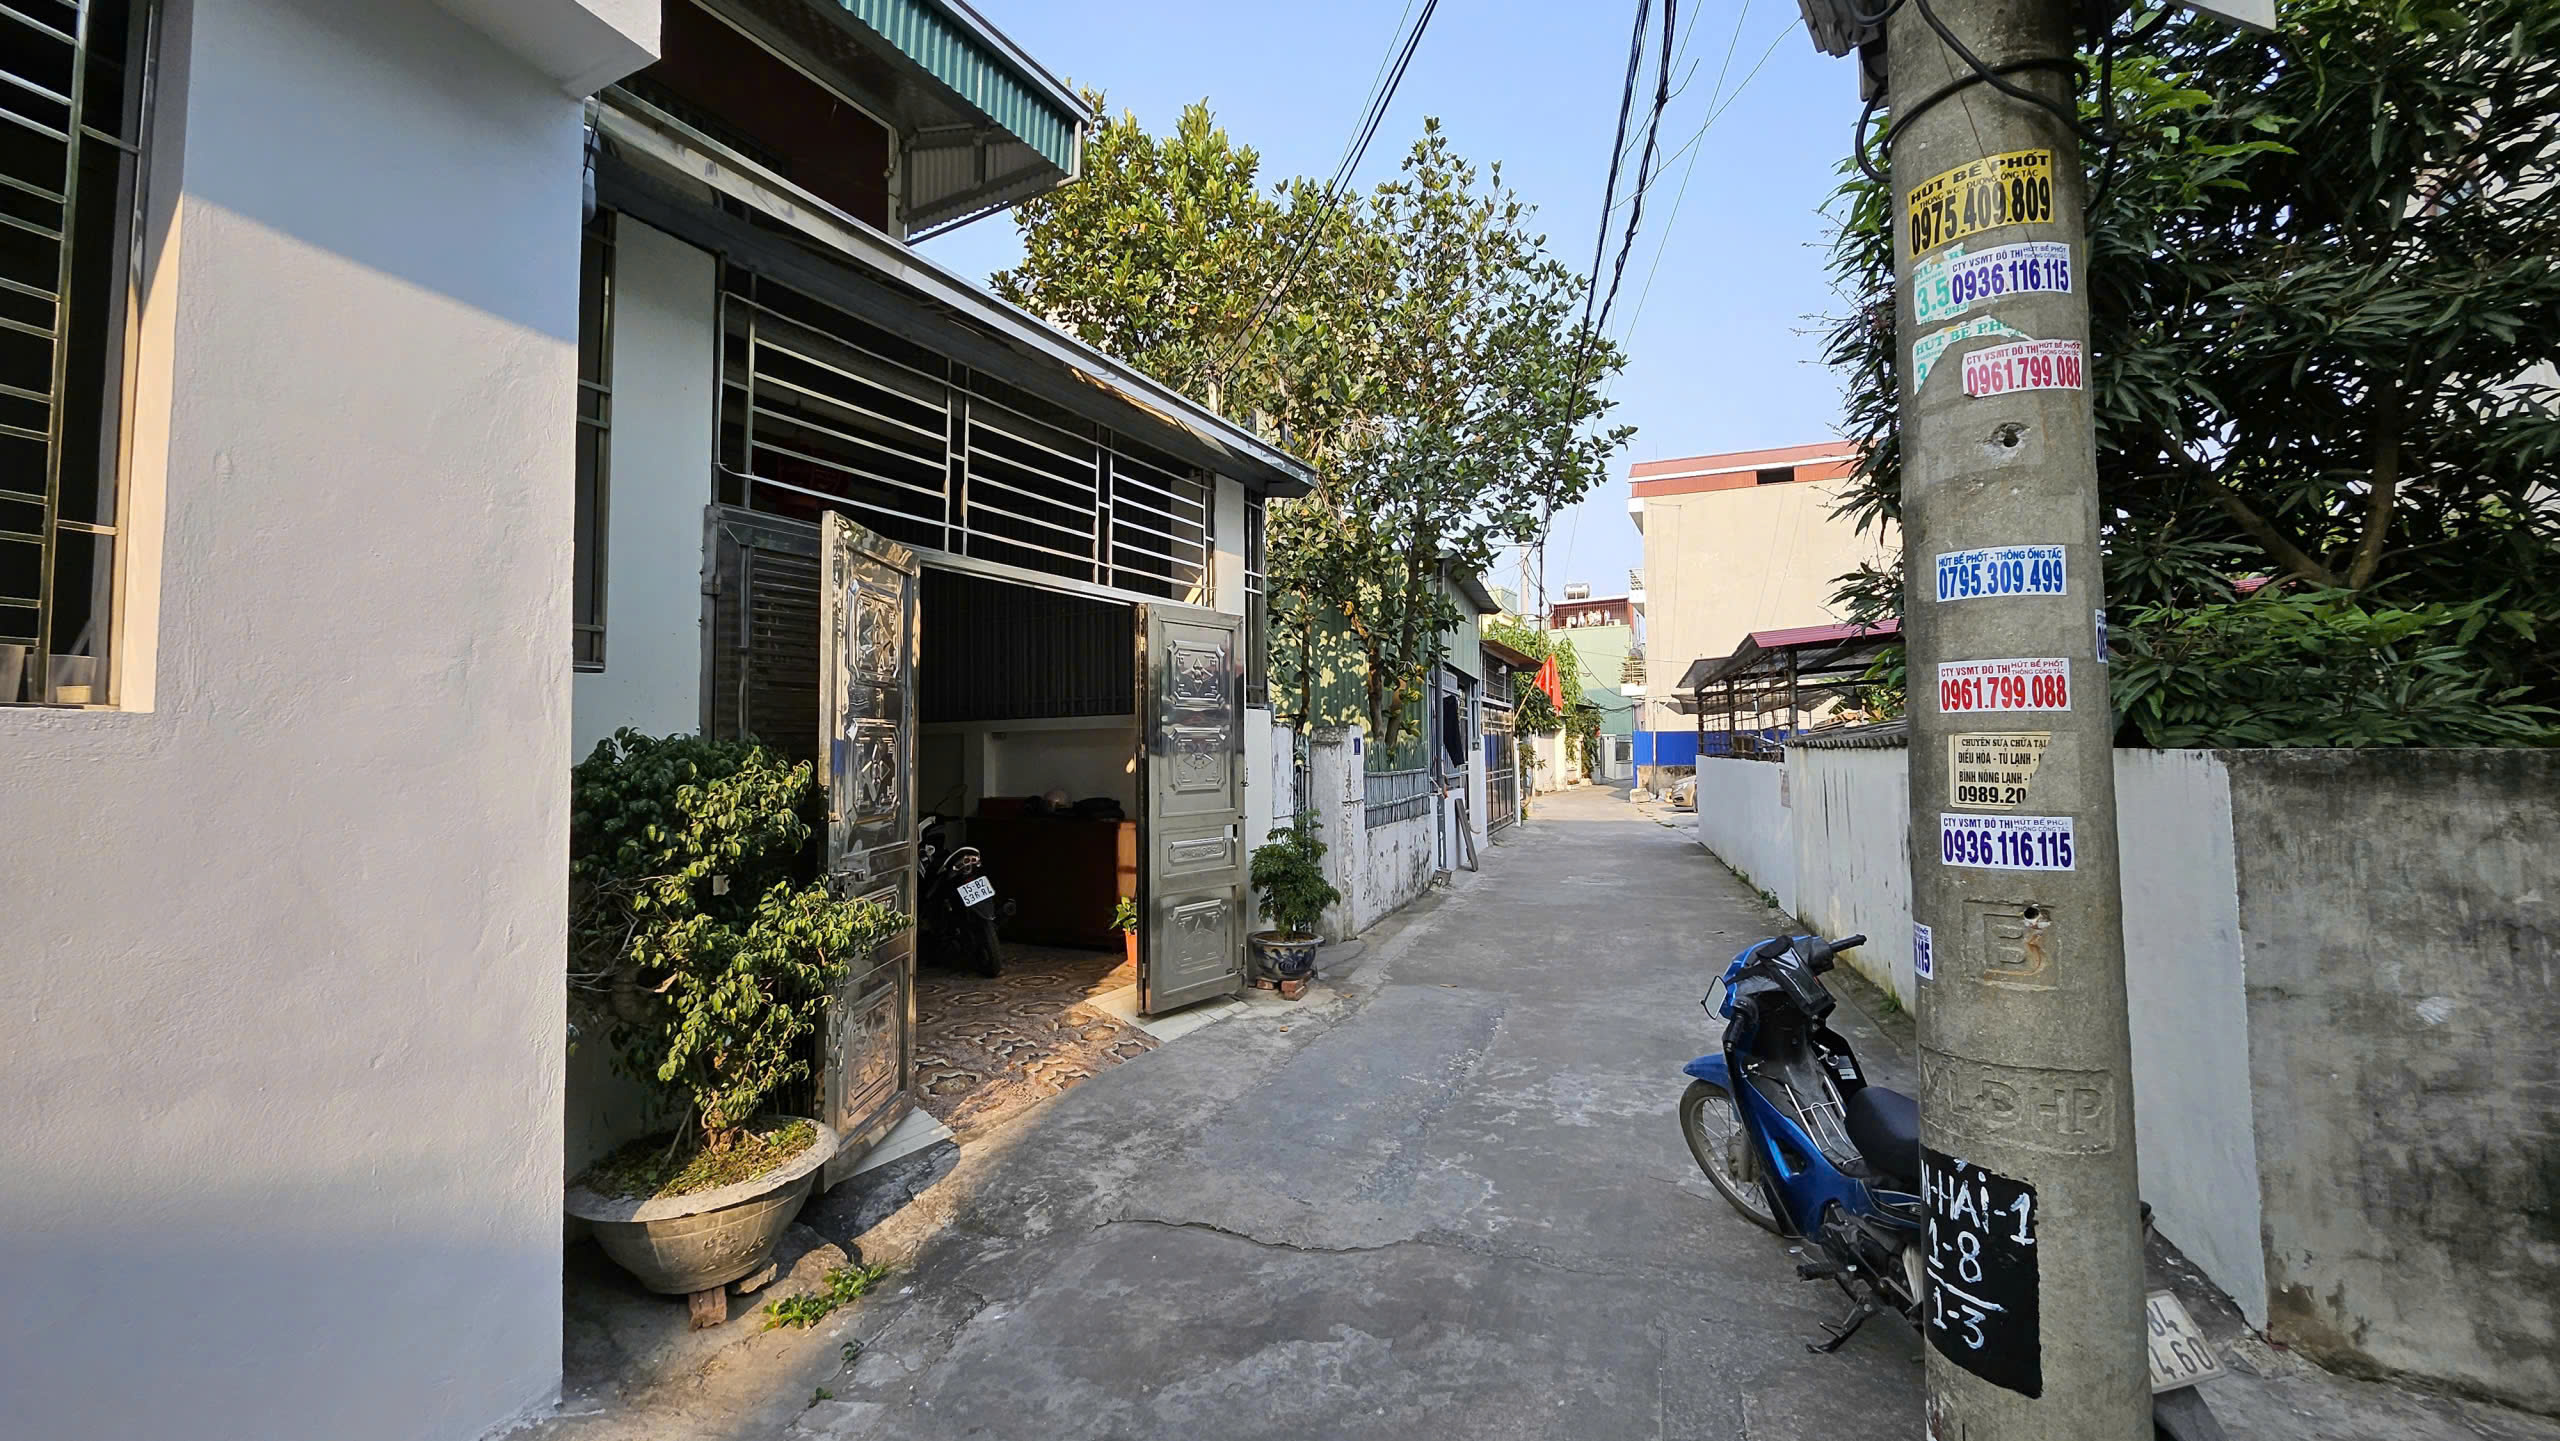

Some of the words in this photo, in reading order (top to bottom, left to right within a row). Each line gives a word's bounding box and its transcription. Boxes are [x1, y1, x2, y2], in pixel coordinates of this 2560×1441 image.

[1991, 151, 2049, 172] PHỐT
[1911, 176, 2050, 256] 0975.409.809
[1952, 260, 1967, 273] CTY
[1969, 254, 1993, 267] VSMT
[1952, 258, 2069, 305] 0936.116.115
[1967, 355, 1981, 366] CTY
[1984, 349, 2009, 361] VSMT
[2012, 344, 2024, 356] ĐÔ
[1967, 355, 2080, 396] 0961.799.088
[1938, 556, 1953, 568] HÚT
[1966, 550, 1988, 563] PHỐT
[1995, 549, 2025, 561] THÔNG
[2027, 547, 2045, 559] ỐNG
[2047, 547, 2062, 559] TẮC
[1939, 560, 2063, 599] 0795.309.499
[1941, 668, 1954, 678] CTY
[1956, 666, 1979, 676] VSMT
[1982, 664, 1994, 675] ĐÔ
[1996, 664, 2011, 676] THỊ
[2011, 660, 2028, 668] HÚT
[1941, 675, 2067, 711] 0961.799.088
[1961, 737, 1990, 747] CHUYÊN
[2010, 753, 2031, 767] LẠNH
[1943, 818, 1956, 827] CTY
[1959, 818, 1981, 828] VSMT
[1984, 818, 1996, 828] ĐÔ
[1943, 829, 2072, 868] 0936.116.115
